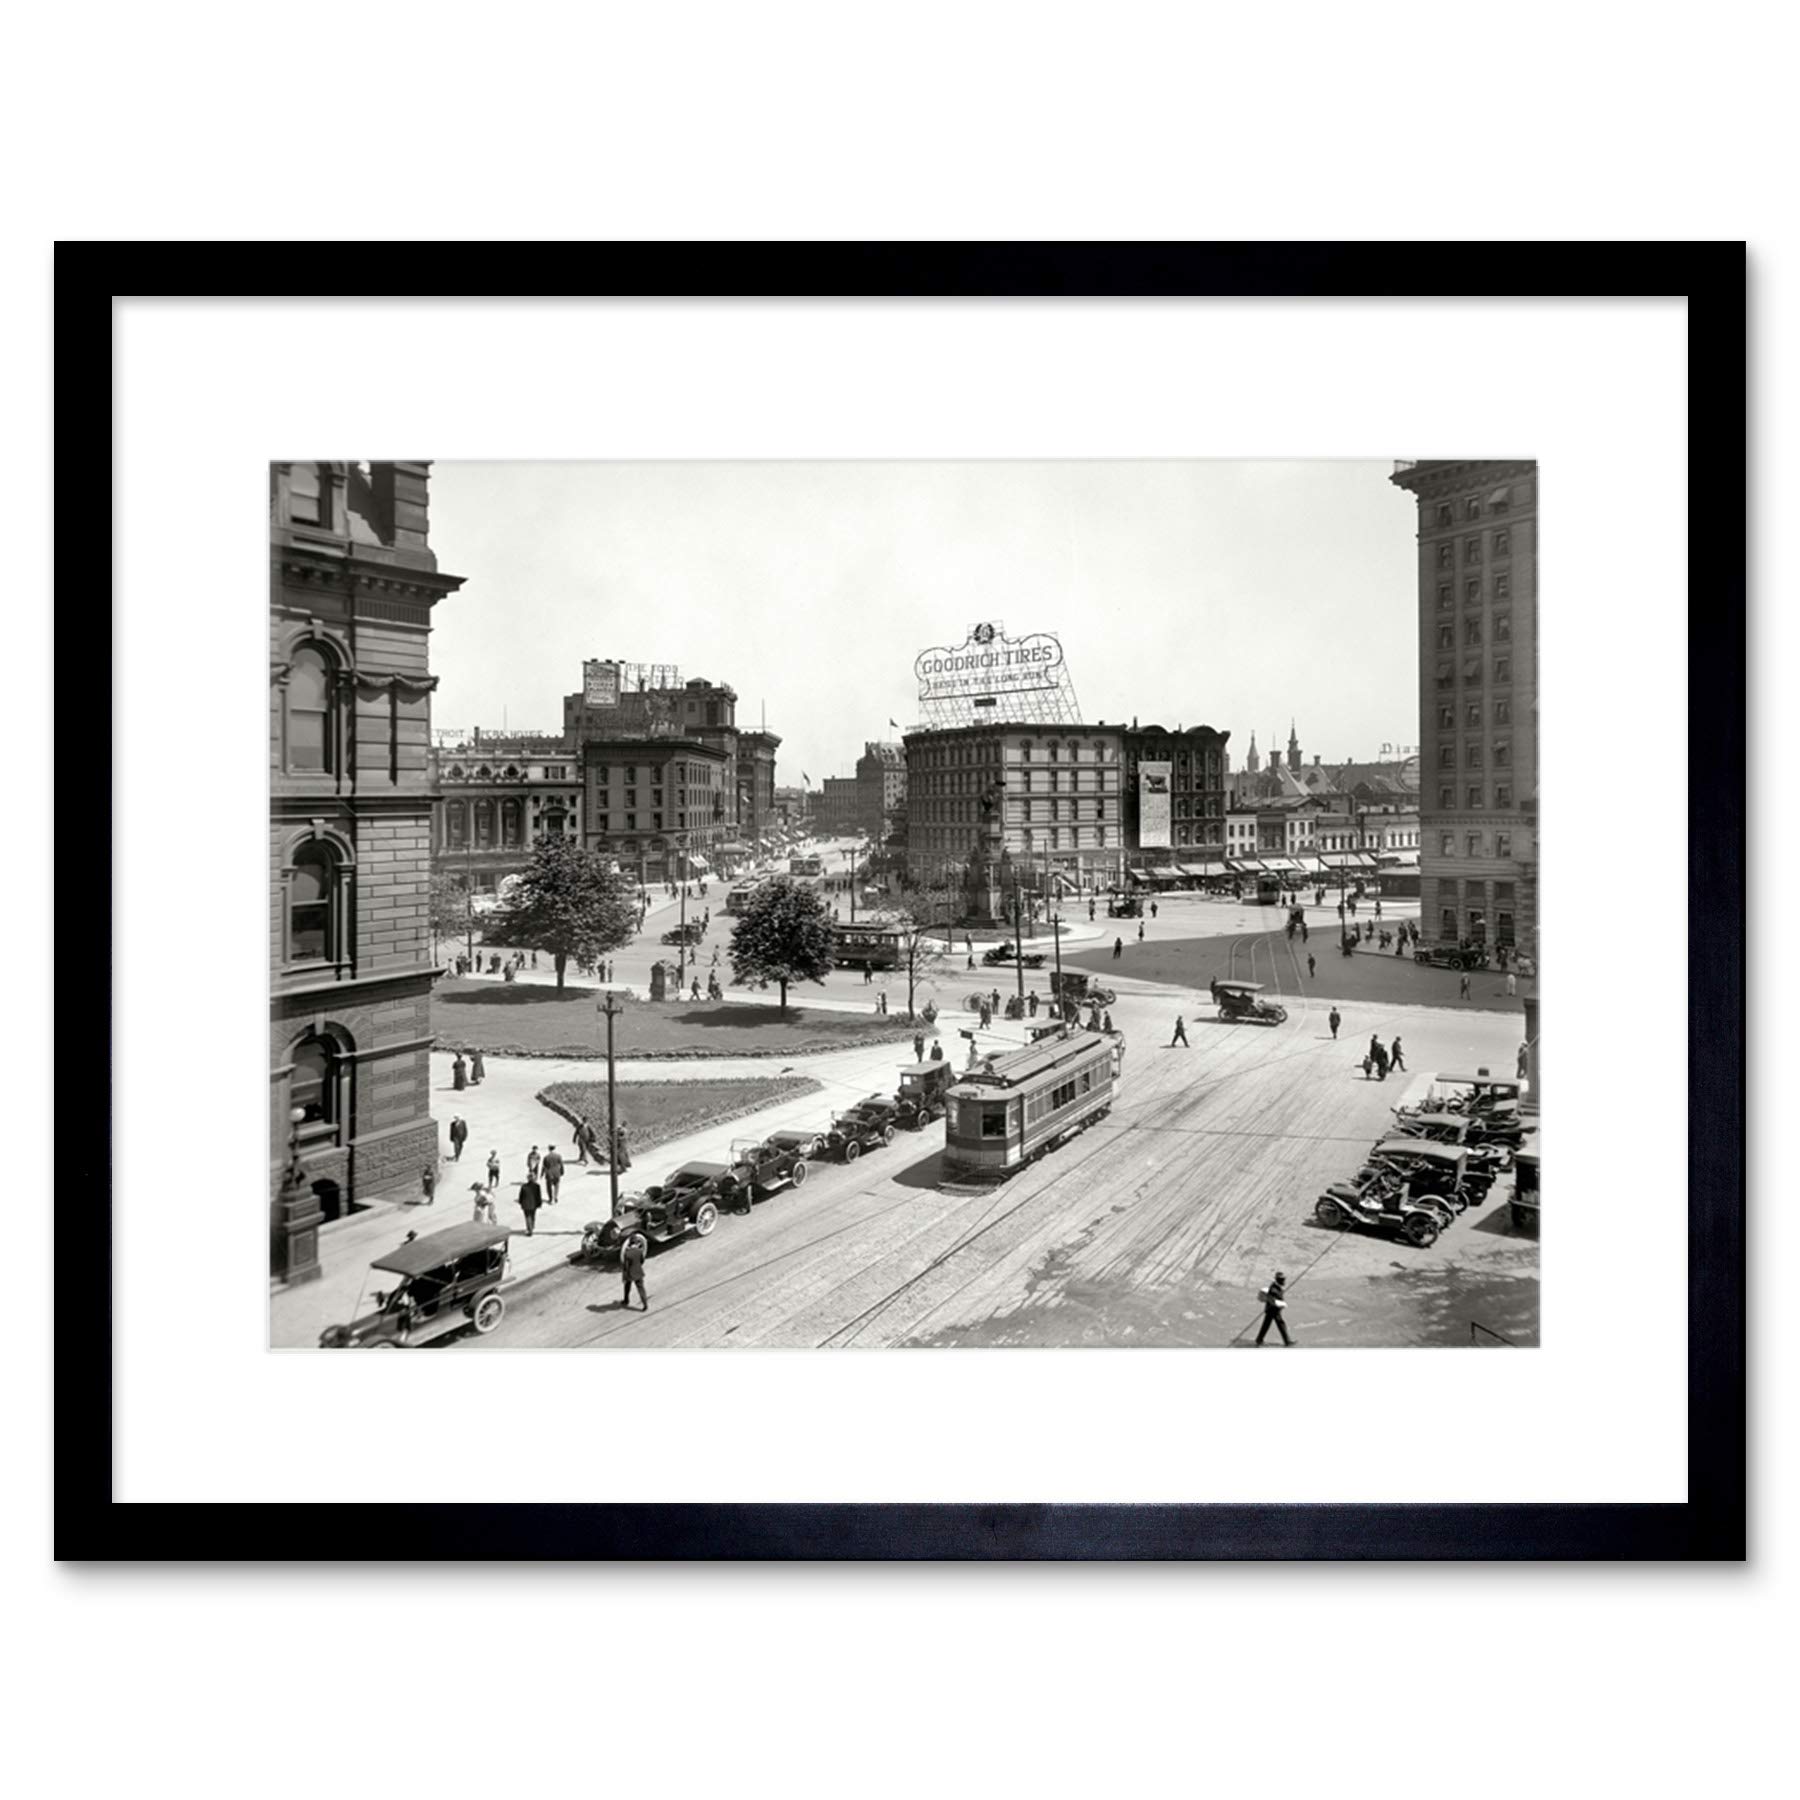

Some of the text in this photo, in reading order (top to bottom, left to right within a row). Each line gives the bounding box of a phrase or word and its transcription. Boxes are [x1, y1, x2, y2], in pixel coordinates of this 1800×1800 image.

[922, 646, 1053, 674] GOODRICH TIRES
[994, 673, 1019, 683] LONG
